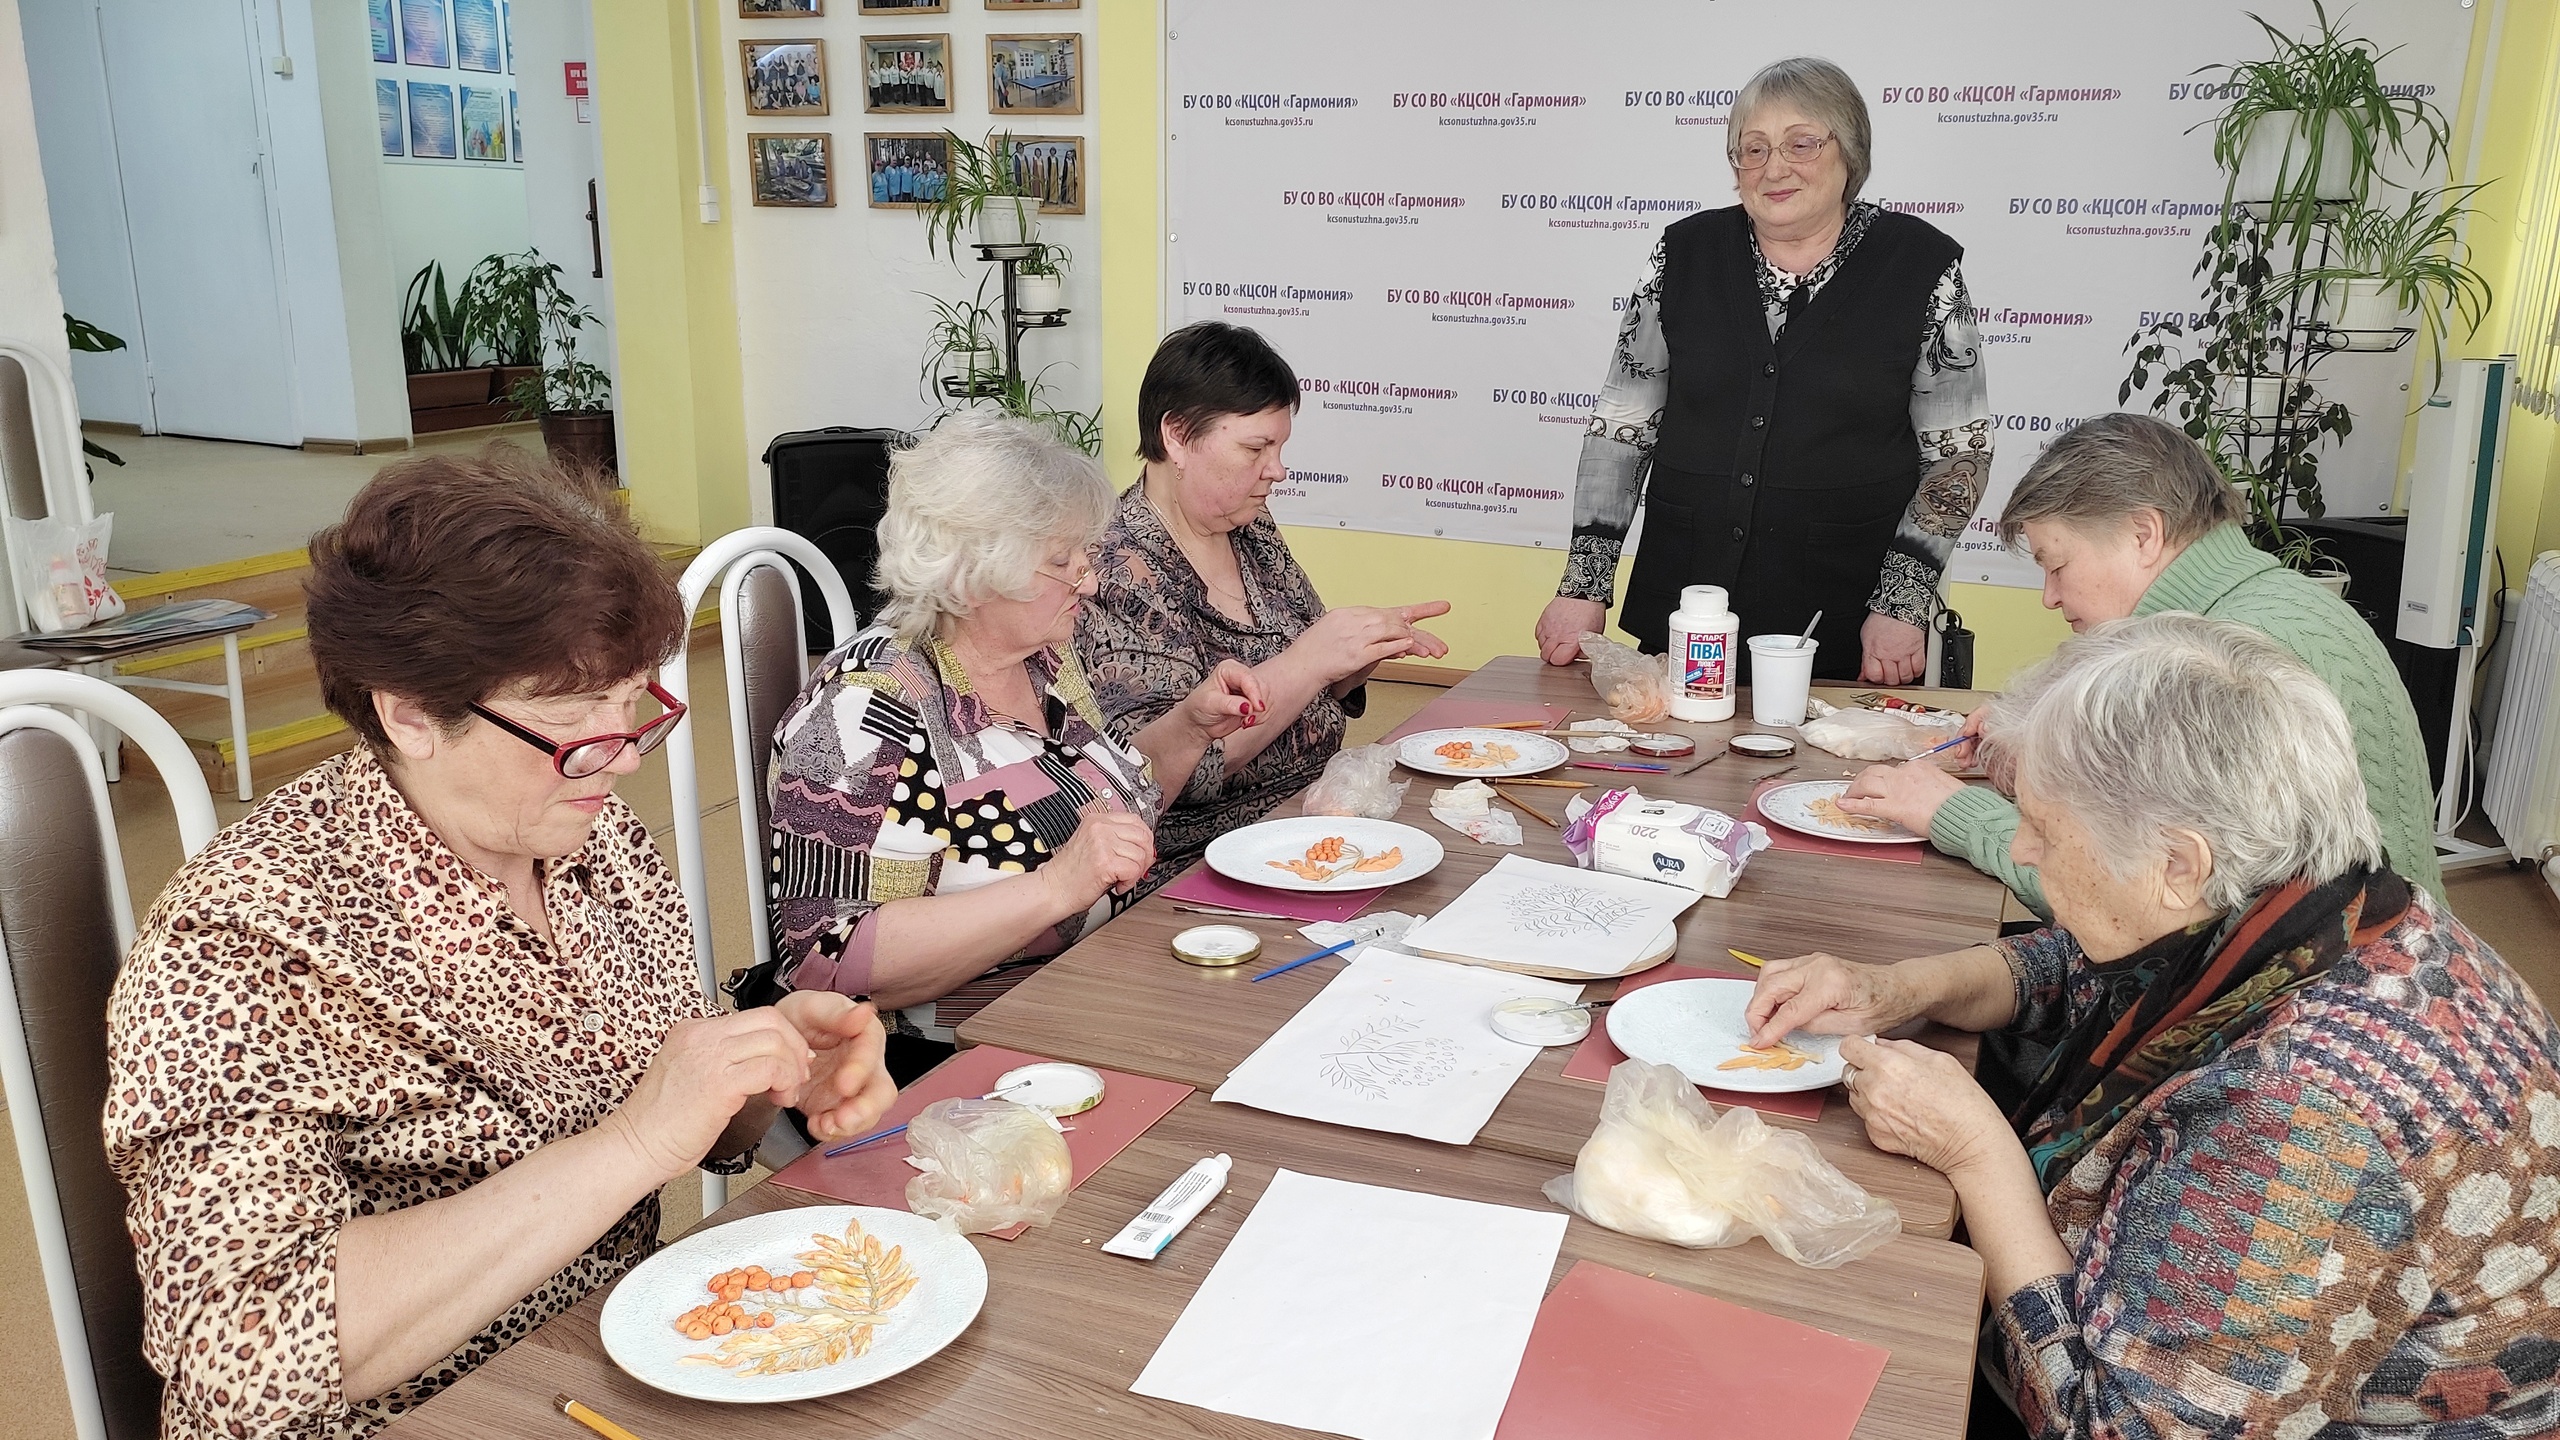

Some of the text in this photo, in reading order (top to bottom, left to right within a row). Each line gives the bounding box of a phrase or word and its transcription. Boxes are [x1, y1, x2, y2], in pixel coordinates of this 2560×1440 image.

[1624, 90, 1643, 107] БУ
[1644, 90, 1663, 107] СО
[1665, 90, 1685, 107] ВО
[1882, 84, 2122, 106] БУ СО ВО «КЦСОН «Гармония»
[2168, 83, 2191, 100] БУ
[2193, 82, 2215, 100] СО
[1183, 93, 1359, 113] БУ СО ВО «КЦСОН «Гармония»
[1392, 91, 1587, 112] БУ СО ВО «КЦСОН «Гармония»
[1224, 116, 1314, 129] kcsonustuzhna.gov35.ru
[1438, 115, 1537, 129] kcsonustuzhna.gov35.ru
[1674, 114, 1729, 126] kcsonustuzh
[1937, 111, 2059, 126] kcsonustuzhna.gov35.ru
[1283, 190, 1466, 211] БУ СО ВО «КЦСОН «Гармония»
[1501, 193, 1702, 214] БУ СО ВО «КЦСОН «Гармония»
[1878, 197, 1965, 214] Гармония»
[2008, 197, 2236, 220] БУ СО ВО «КЦСОН «Гармон
[1326, 213, 1419, 227] kcsonustuzhna.gov35.ru
[1548, 217, 1650, 232] kcsonustuzhna.gov35.ru
[2065, 223, 2192, 239] kcsonustuzhna.gov35.ru
[1182, 281, 1354, 304] БУ СО ВО «КЦСОН «Гармония»
[1387, 288, 1576, 312] БУ СО ВО «КЦСОН «Гармония»
[1223, 303, 1310, 318] kcsonustuzhna.gov35.ru
[1612, 296, 1630, 312] БУ
[1431, 312, 1527, 327] kcsonustuzhna.gov35.ru
[1993, 307, 2094, 329] «Гармония»
[2138, 311, 2161, 328] БУ
[1299, 377, 1459, 401] СО ВО «КЦСОН «Гармония»
[1492, 388, 1510, 404] БУ
[1510, 389, 1527, 405] СО
[1529, 390, 1548, 406] ВО
[1322, 399, 1413, 415] kcsonustuzhna.gov35.ru
[1538, 412, 1588, 426] kcsonustuzh
[2006, 414, 2027, 431] СО
[2029, 415, 2052, 432] ВО
[1284, 466, 1350, 485] армония»
[1381, 473, 1565, 501] БУ СО ВО «КЦСОН «Гармония»
[1425, 498, 1518, 514] kcsonustuzhna.gov35.ru
[1690, 643, 1724, 660] ПВА
[1631, 824, 1660, 840] 220
[1655, 857, 1681, 870] AURA
